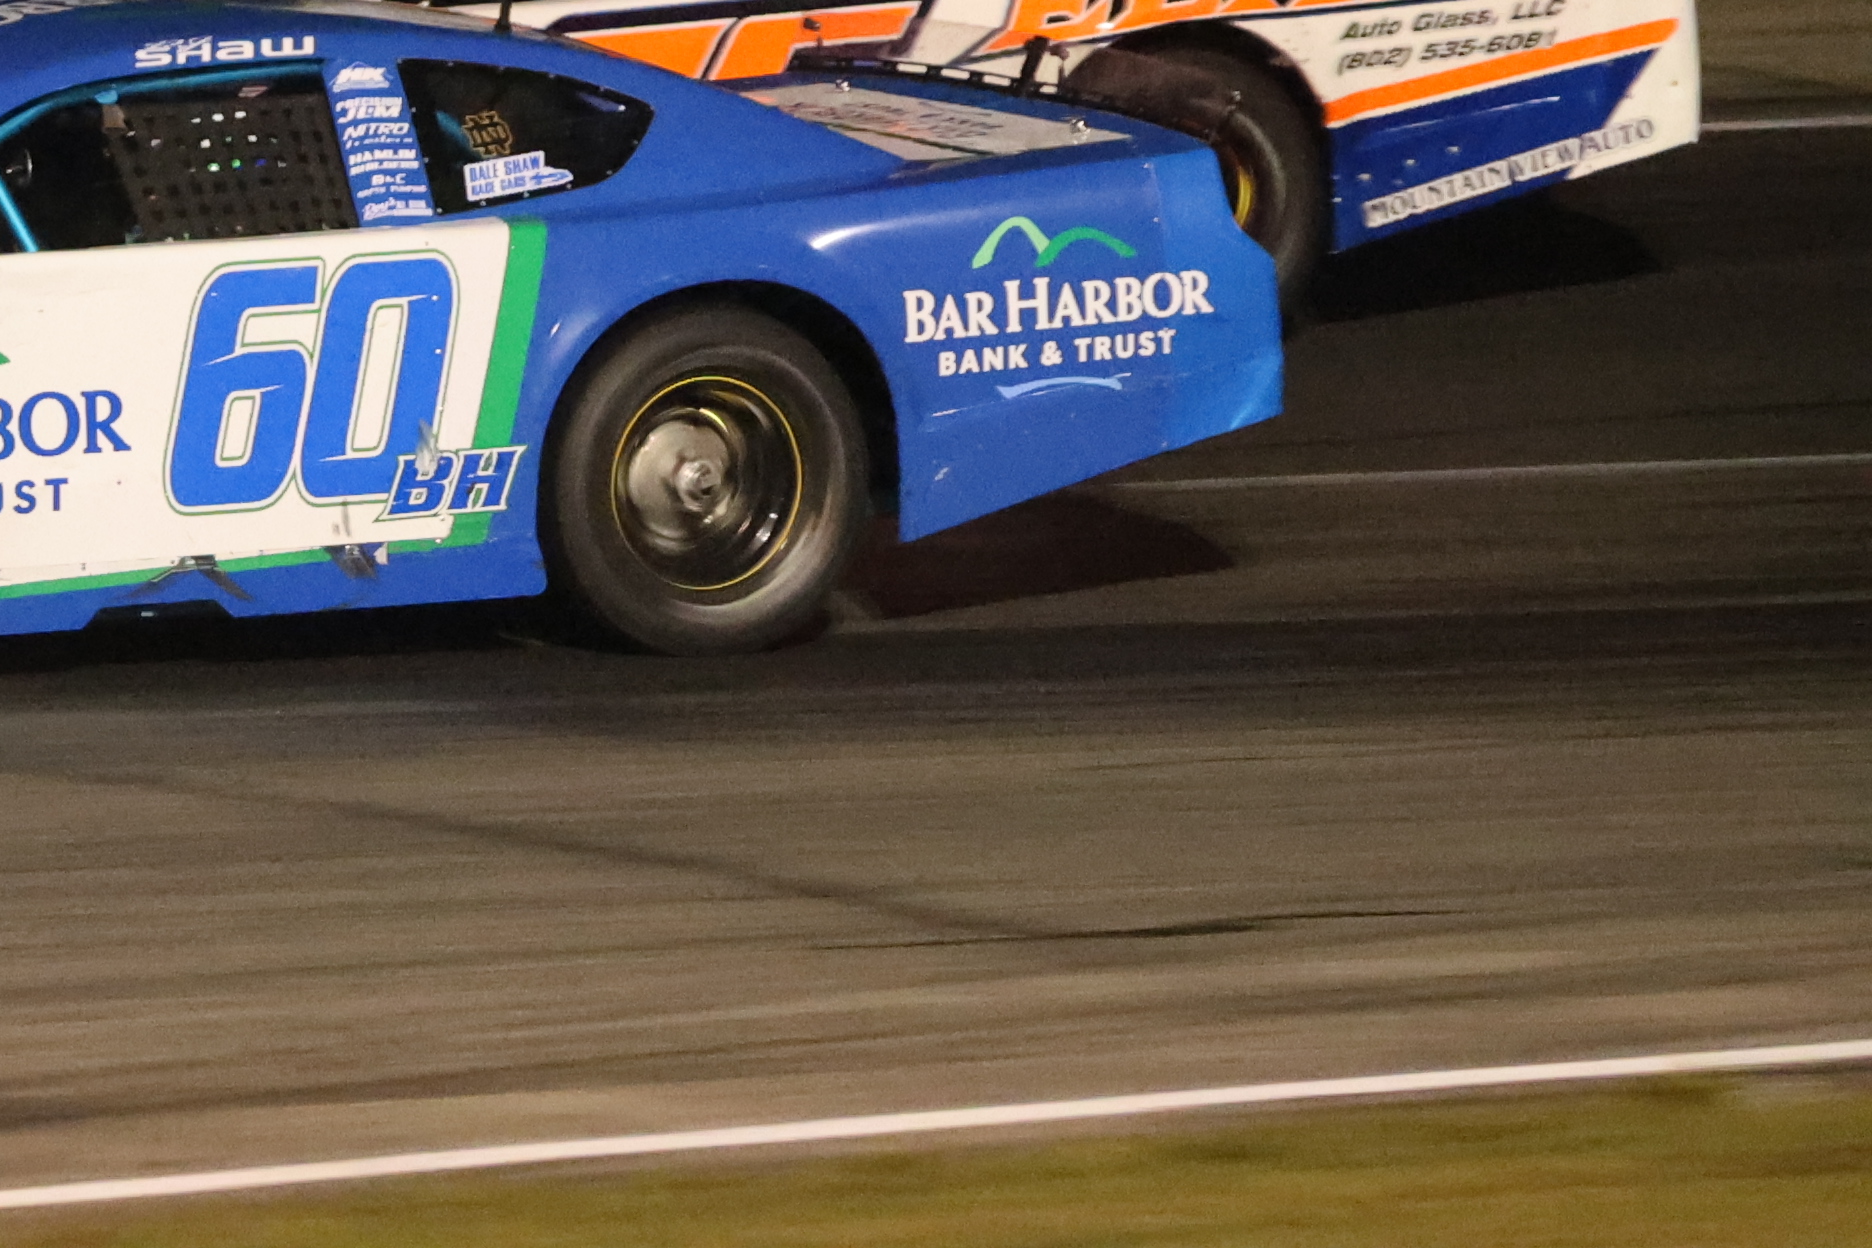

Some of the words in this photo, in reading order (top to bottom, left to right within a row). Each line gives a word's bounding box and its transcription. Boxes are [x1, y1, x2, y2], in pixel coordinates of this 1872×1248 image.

[1339, 18, 1403, 40] Auto
[1411, 8, 1499, 33] Glass,
[1336, 46, 1413, 76] (802)
[342, 122, 410, 141] NITRO
[469, 163, 499, 182] DALE
[503, 155, 541, 176] SHAW
[1365, 163, 1511, 224] MOUNTAIN
[1509, 141, 1579, 178] VIEW
[1578, 118, 1656, 157] AUTO
[902, 288, 999, 344] BAR
[1003, 269, 1215, 334] HARBOR
[938, 343, 1029, 377] BANK
[1040, 340, 1064, 367] &
[1073, 327, 1178, 363] TRUST
[164, 250, 459, 515] 60
[378, 448, 523, 520] BH
